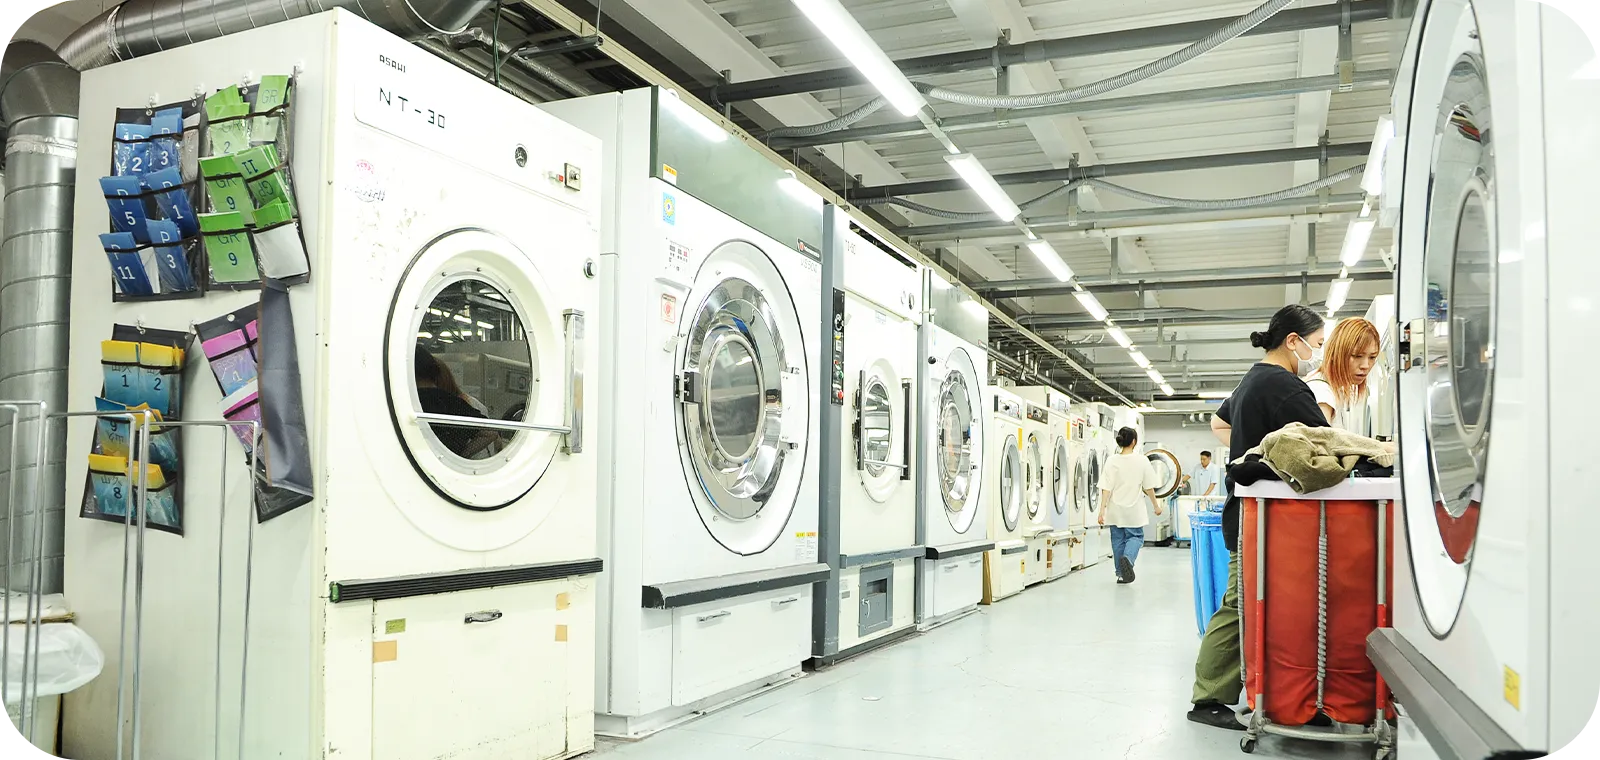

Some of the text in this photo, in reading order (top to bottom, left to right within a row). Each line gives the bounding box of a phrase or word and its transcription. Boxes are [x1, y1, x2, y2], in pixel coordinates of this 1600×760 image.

[379, 54, 406, 73] ASAHI
[261, 89, 278, 104] GR
[132, 134, 145, 151] P
[223, 141, 231, 153] 2
[131, 156, 143, 172] 2
[160, 150, 169, 166] 3
[116, 189, 129, 206] P
[226, 196, 236, 210] 9
[124, 211, 136, 226] 5
[172, 204, 184, 220] 1
[160, 230, 170, 243] P
[166, 254, 176, 269] 3
[228, 252, 238, 266] 9
[117, 265, 136, 280] 11
[121, 374, 130, 388] 1
[153, 377, 162, 391] 2
[113, 486, 123, 499] 8
